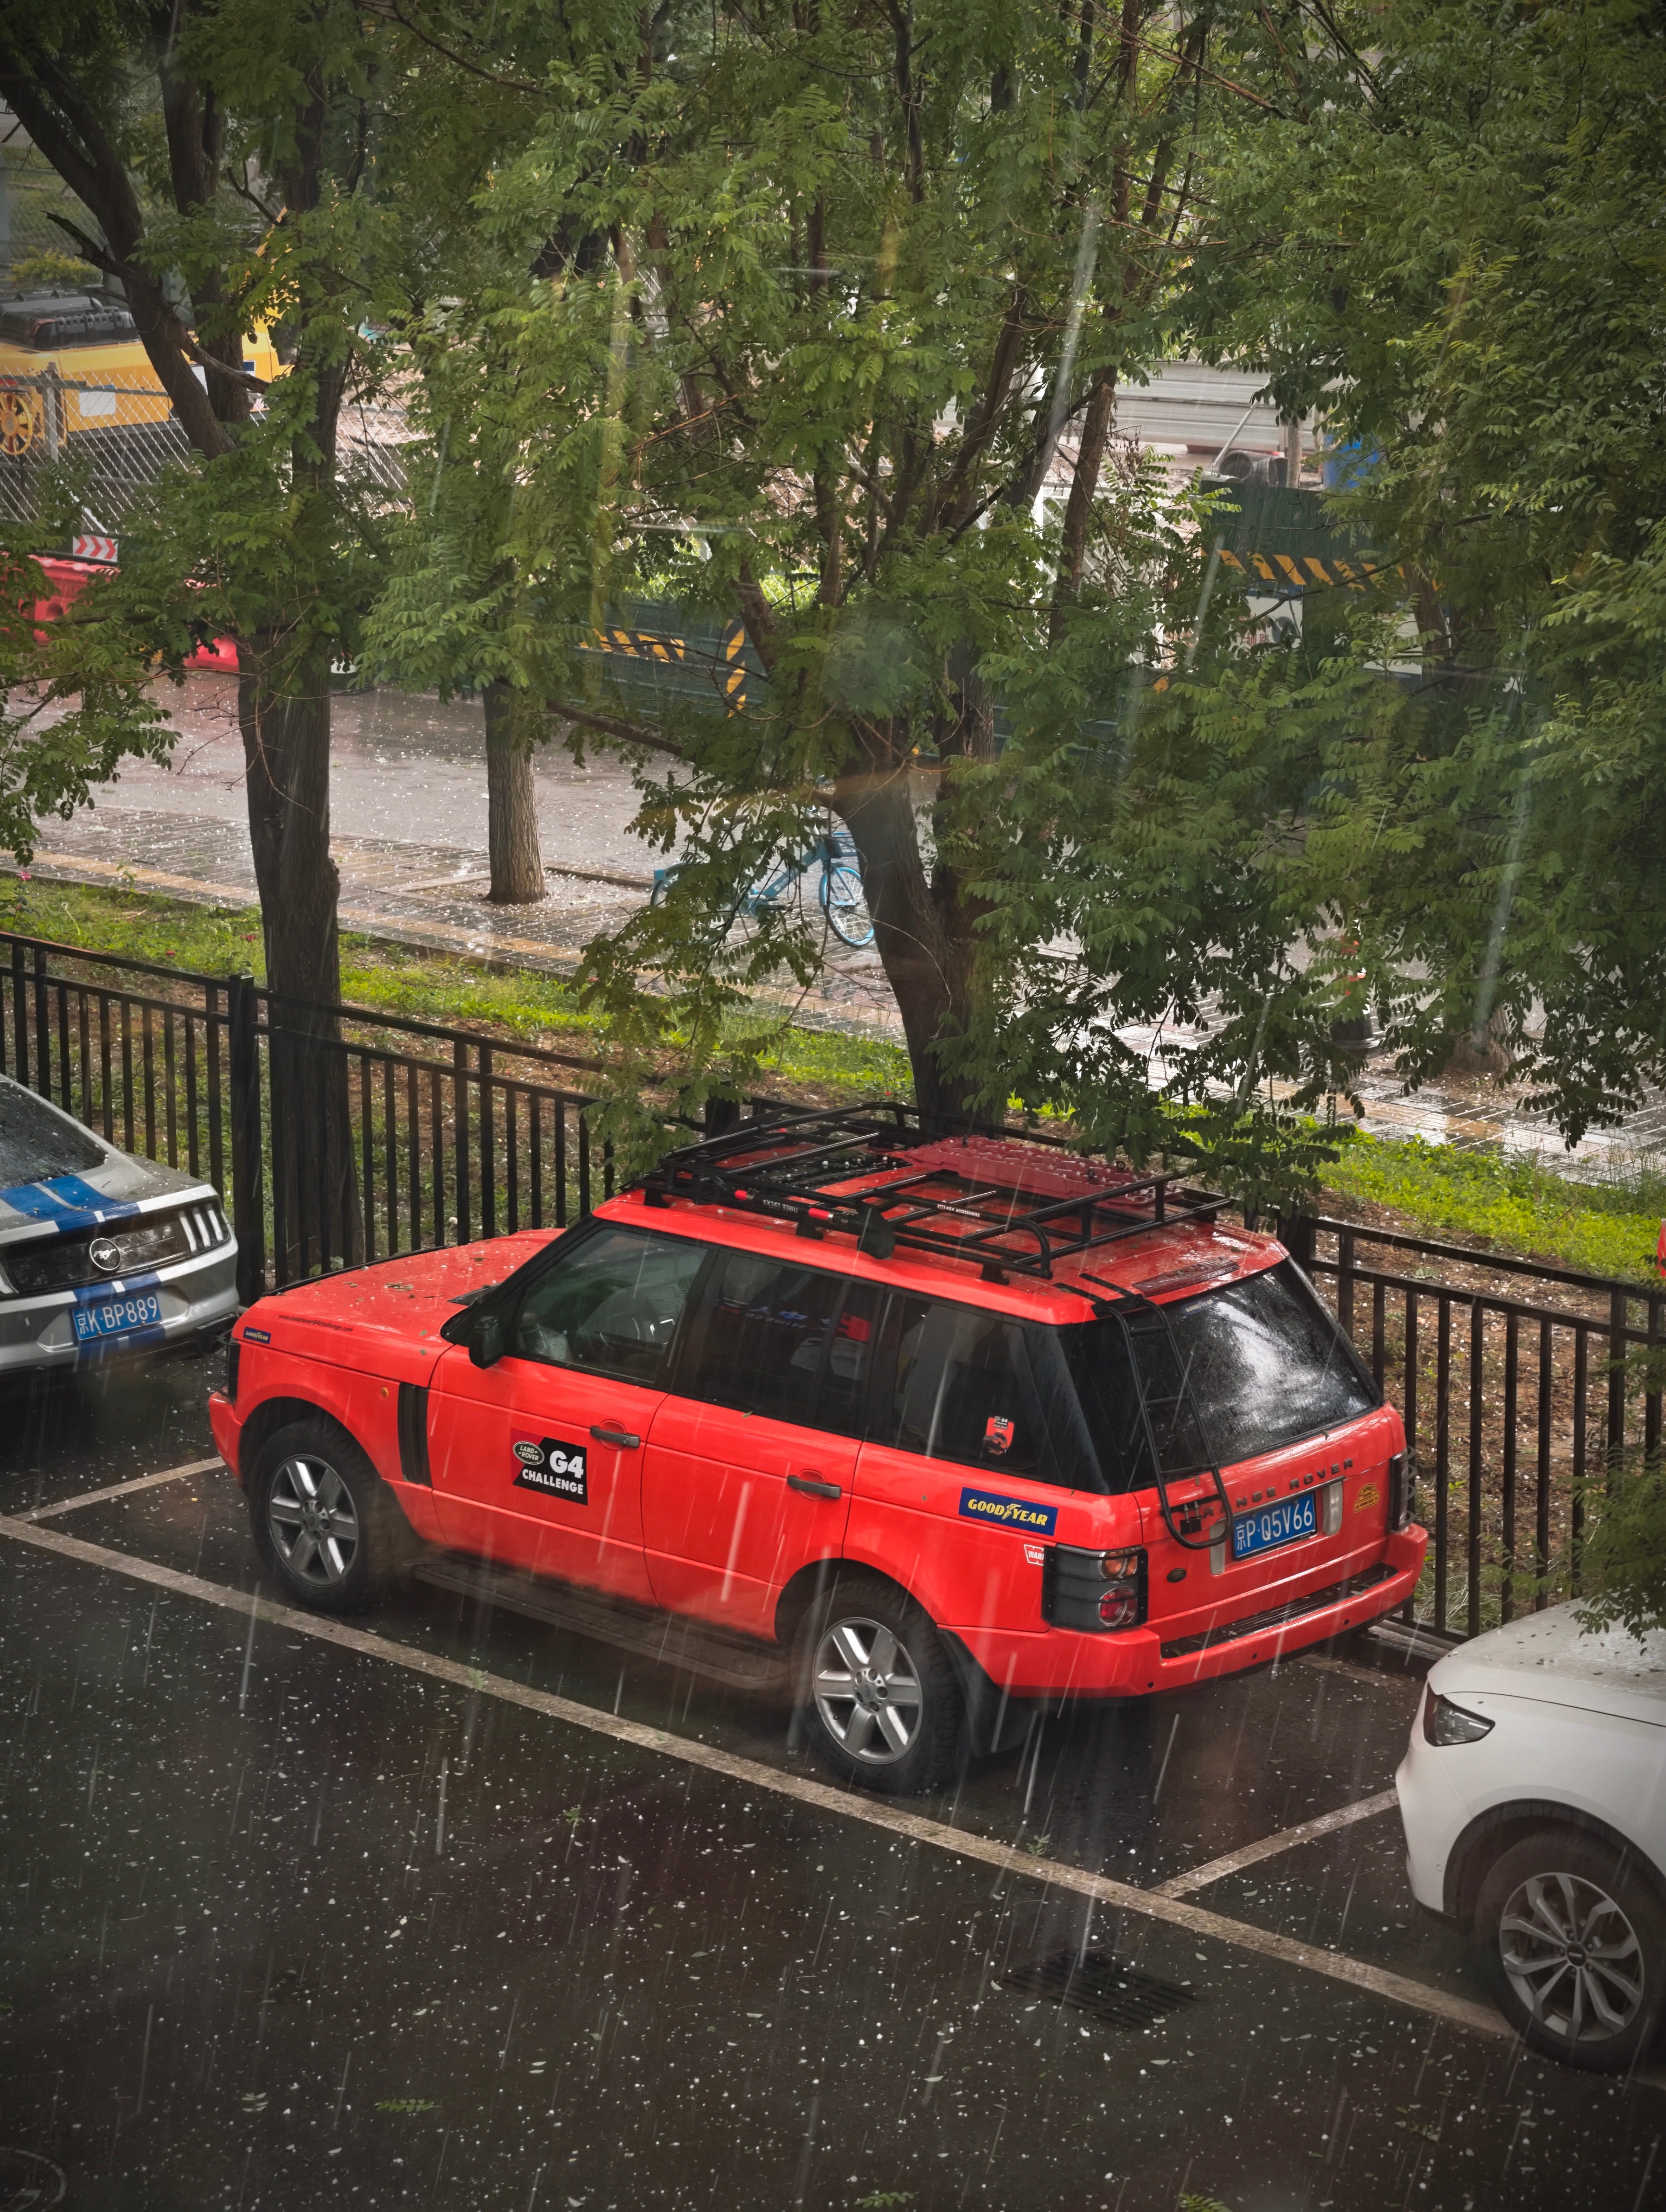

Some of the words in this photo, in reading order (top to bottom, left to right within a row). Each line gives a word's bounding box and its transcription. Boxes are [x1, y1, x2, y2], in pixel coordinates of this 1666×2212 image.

[782, 1204, 798, 1213] THREE
[956, 1208, 981, 1218] ACCESSORIES
[520, 1445, 535, 1454] LAND
[521, 1451, 539, 1461] ROVER
[550, 1450, 584, 1478] G4
[522, 1469, 584, 1495] CHALLENGE
[1203, 1487, 1276, 1518] RNGE
[1290, 1458, 1353, 1490] ROVER
[968, 1499, 1048, 1526] GOODYEAR
